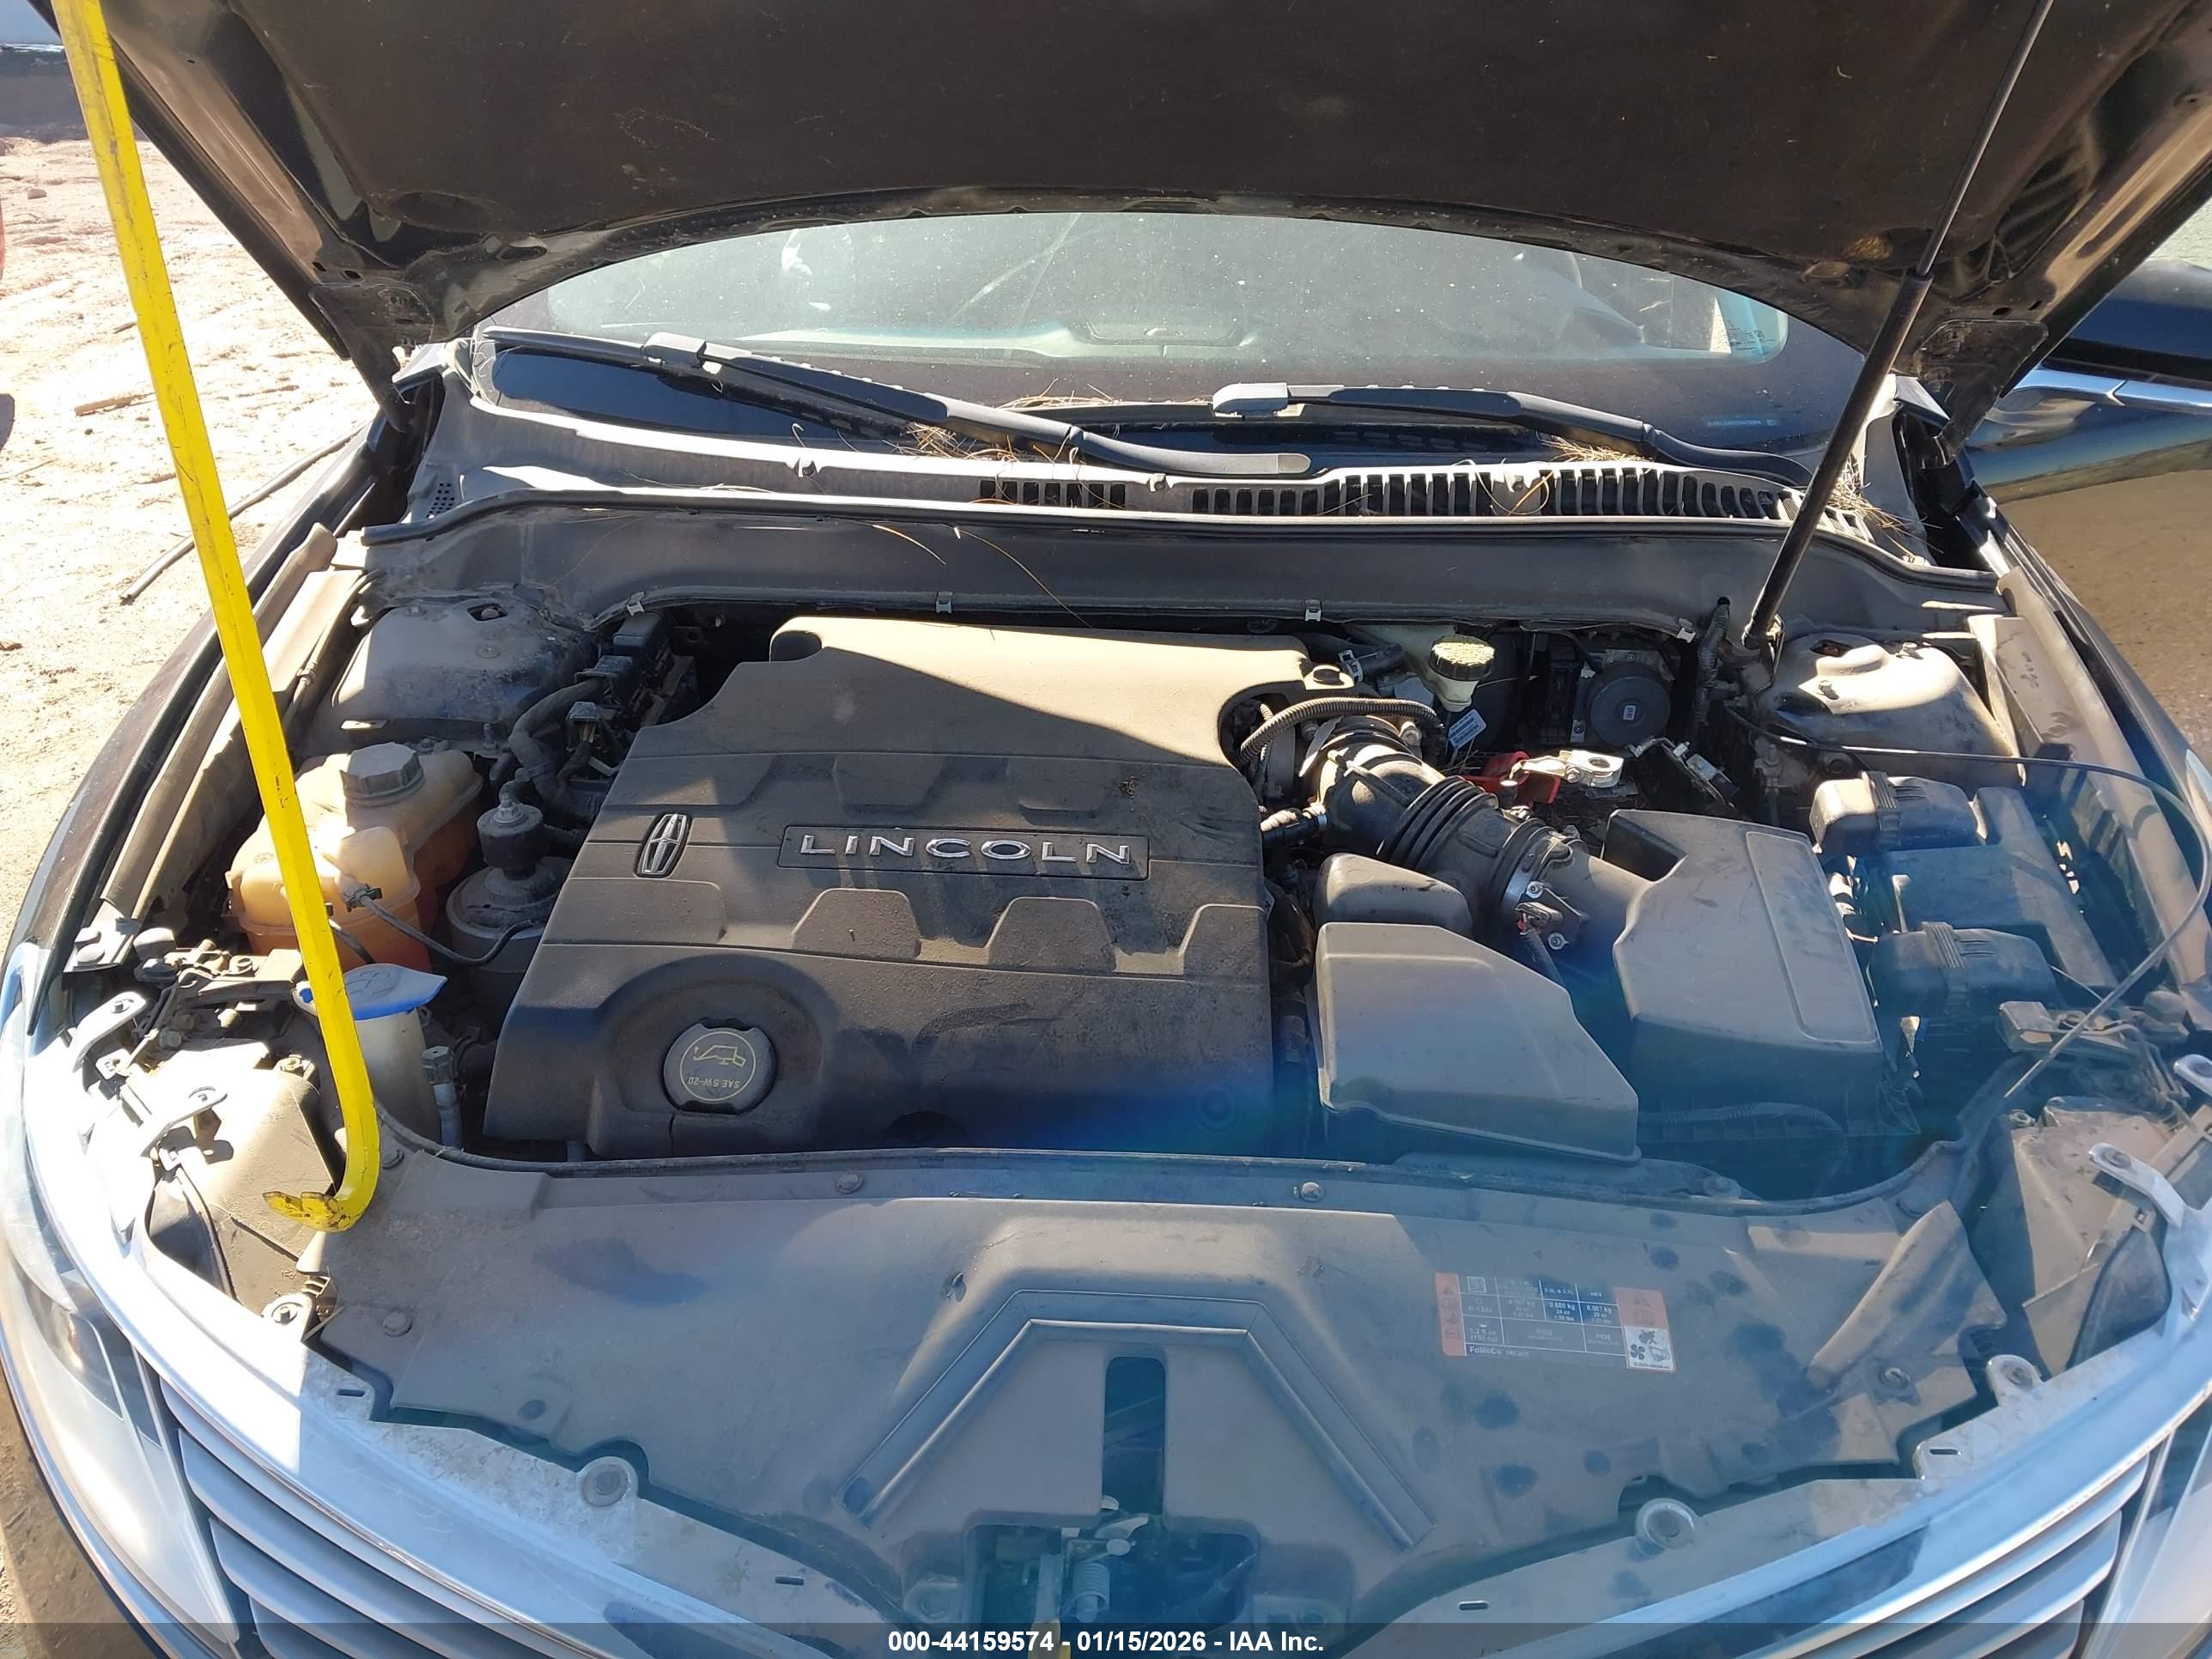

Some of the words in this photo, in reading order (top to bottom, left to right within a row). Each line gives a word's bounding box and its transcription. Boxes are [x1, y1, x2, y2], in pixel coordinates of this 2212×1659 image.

[800, 834, 1131, 865] LINCOLN
[688, 1077, 719, 1087] 5W-20
[721, 1079, 740, 1088] SAE
[1603, 1305, 1613, 1315] kg
[1469, 1346, 1502, 1356] FoMoCo
